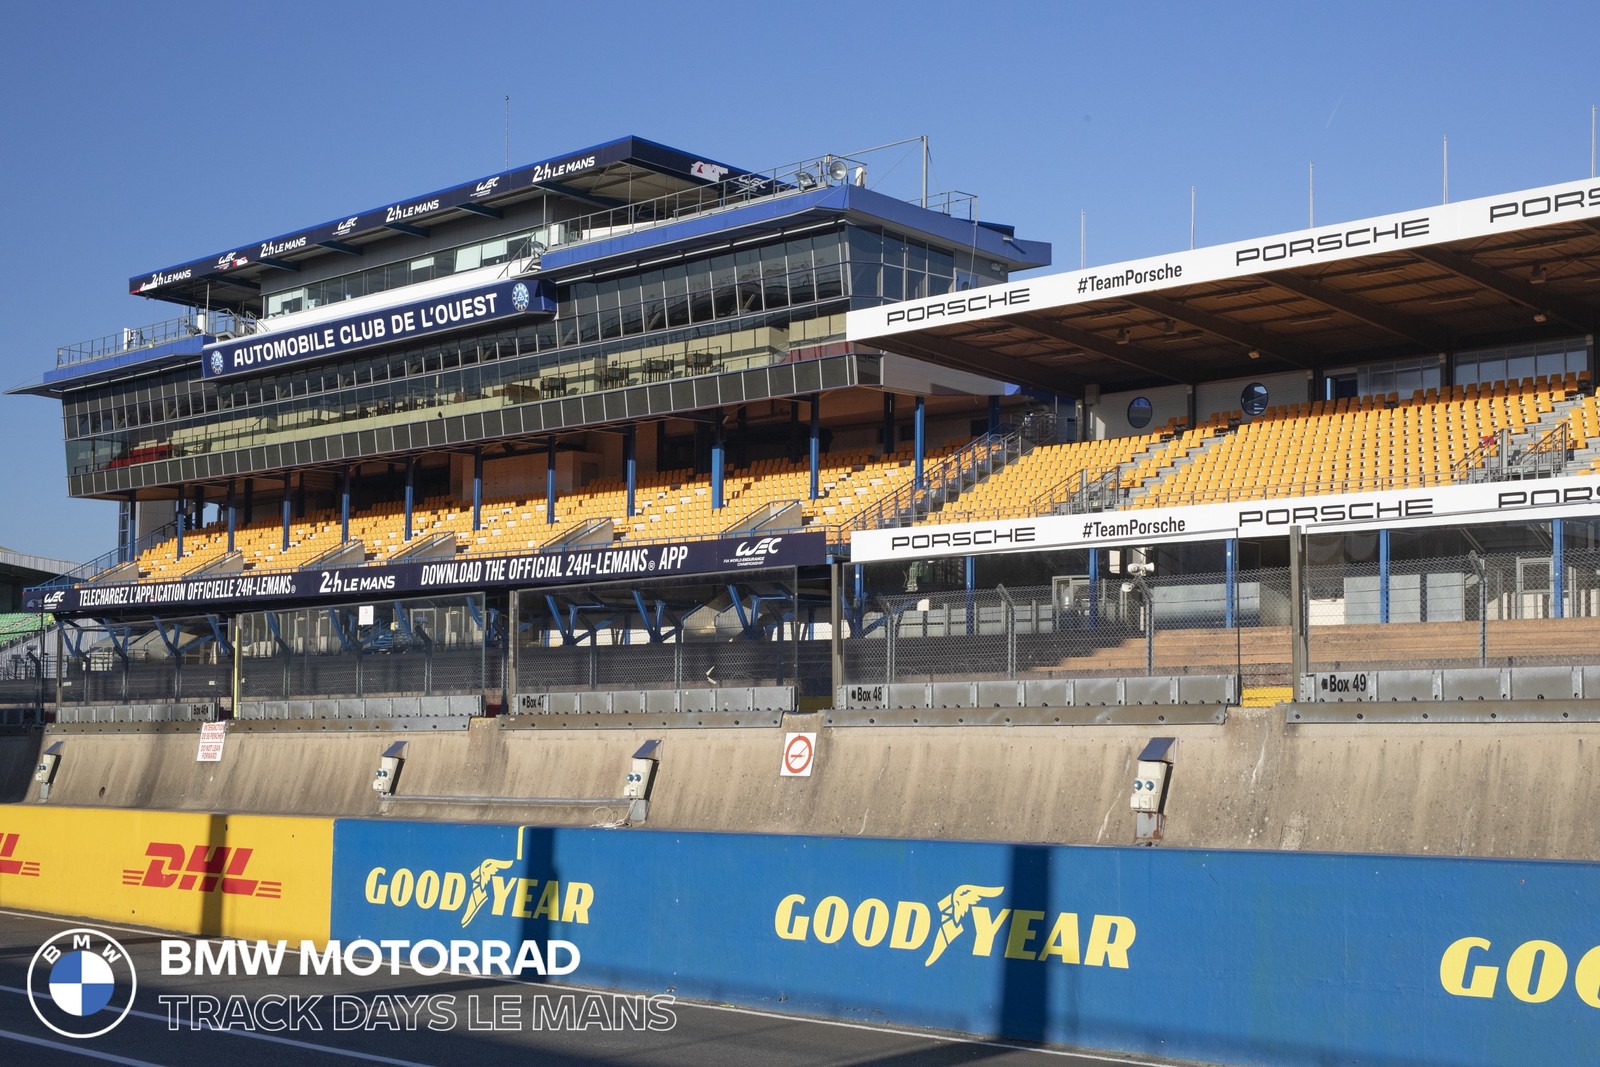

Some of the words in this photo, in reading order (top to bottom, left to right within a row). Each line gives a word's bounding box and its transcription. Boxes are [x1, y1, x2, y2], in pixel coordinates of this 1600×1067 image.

[552, 165, 565, 176] LE
[566, 156, 595, 173] MANS
[476, 177, 499, 191] WEC
[403, 208, 413, 217] LE
[415, 200, 439, 215] MANS
[338, 217, 358, 230] WEC
[275, 244, 283, 253] LE
[285, 237, 306, 250] MANS
[1236, 218, 1430, 266] PORSCHE
[164, 276, 172, 284] LE
[173, 270, 191, 282] MANS
[1078, 264, 1183, 293] #TeamPorsche
[887, 288, 1030, 326] PORSCHE
[234, 328, 334, 367] AUTOMOBILE
[340, 318, 386, 343] CLUB
[392, 311, 415, 334] DE
[421, 293, 497, 328] L'OUEST
[1239, 498, 1433, 527] PORSCHE
[1083, 516, 1186, 538] #TeamPorsche
[736, 538, 782, 557] WEC
[892, 527, 1035, 551] PORSCHE
[421, 561, 482, 585] DOWNLOAD
[485, 559, 506, 581] THE
[509, 556, 562, 579] OFFICIAL
[659, 546, 688, 570] APP
[79, 585, 129, 606] TELECHARGEZ
[130, 582, 185, 604] L'APPLICATION
[187, 578, 235, 600] OFFICIELLE
[319, 571, 342, 593] 24h
[343, 578, 358, 591] LE
[360, 576, 395, 590] MANS
[44, 591, 65, 603] WEC
[858, 687, 871, 701] Box
[873, 686, 882, 701] 48
[1330, 674, 1350, 692] Box
[1352, 674, 1366, 692] 49
[527, 696, 536, 708] Box
[142, 842, 259, 896] DHL
